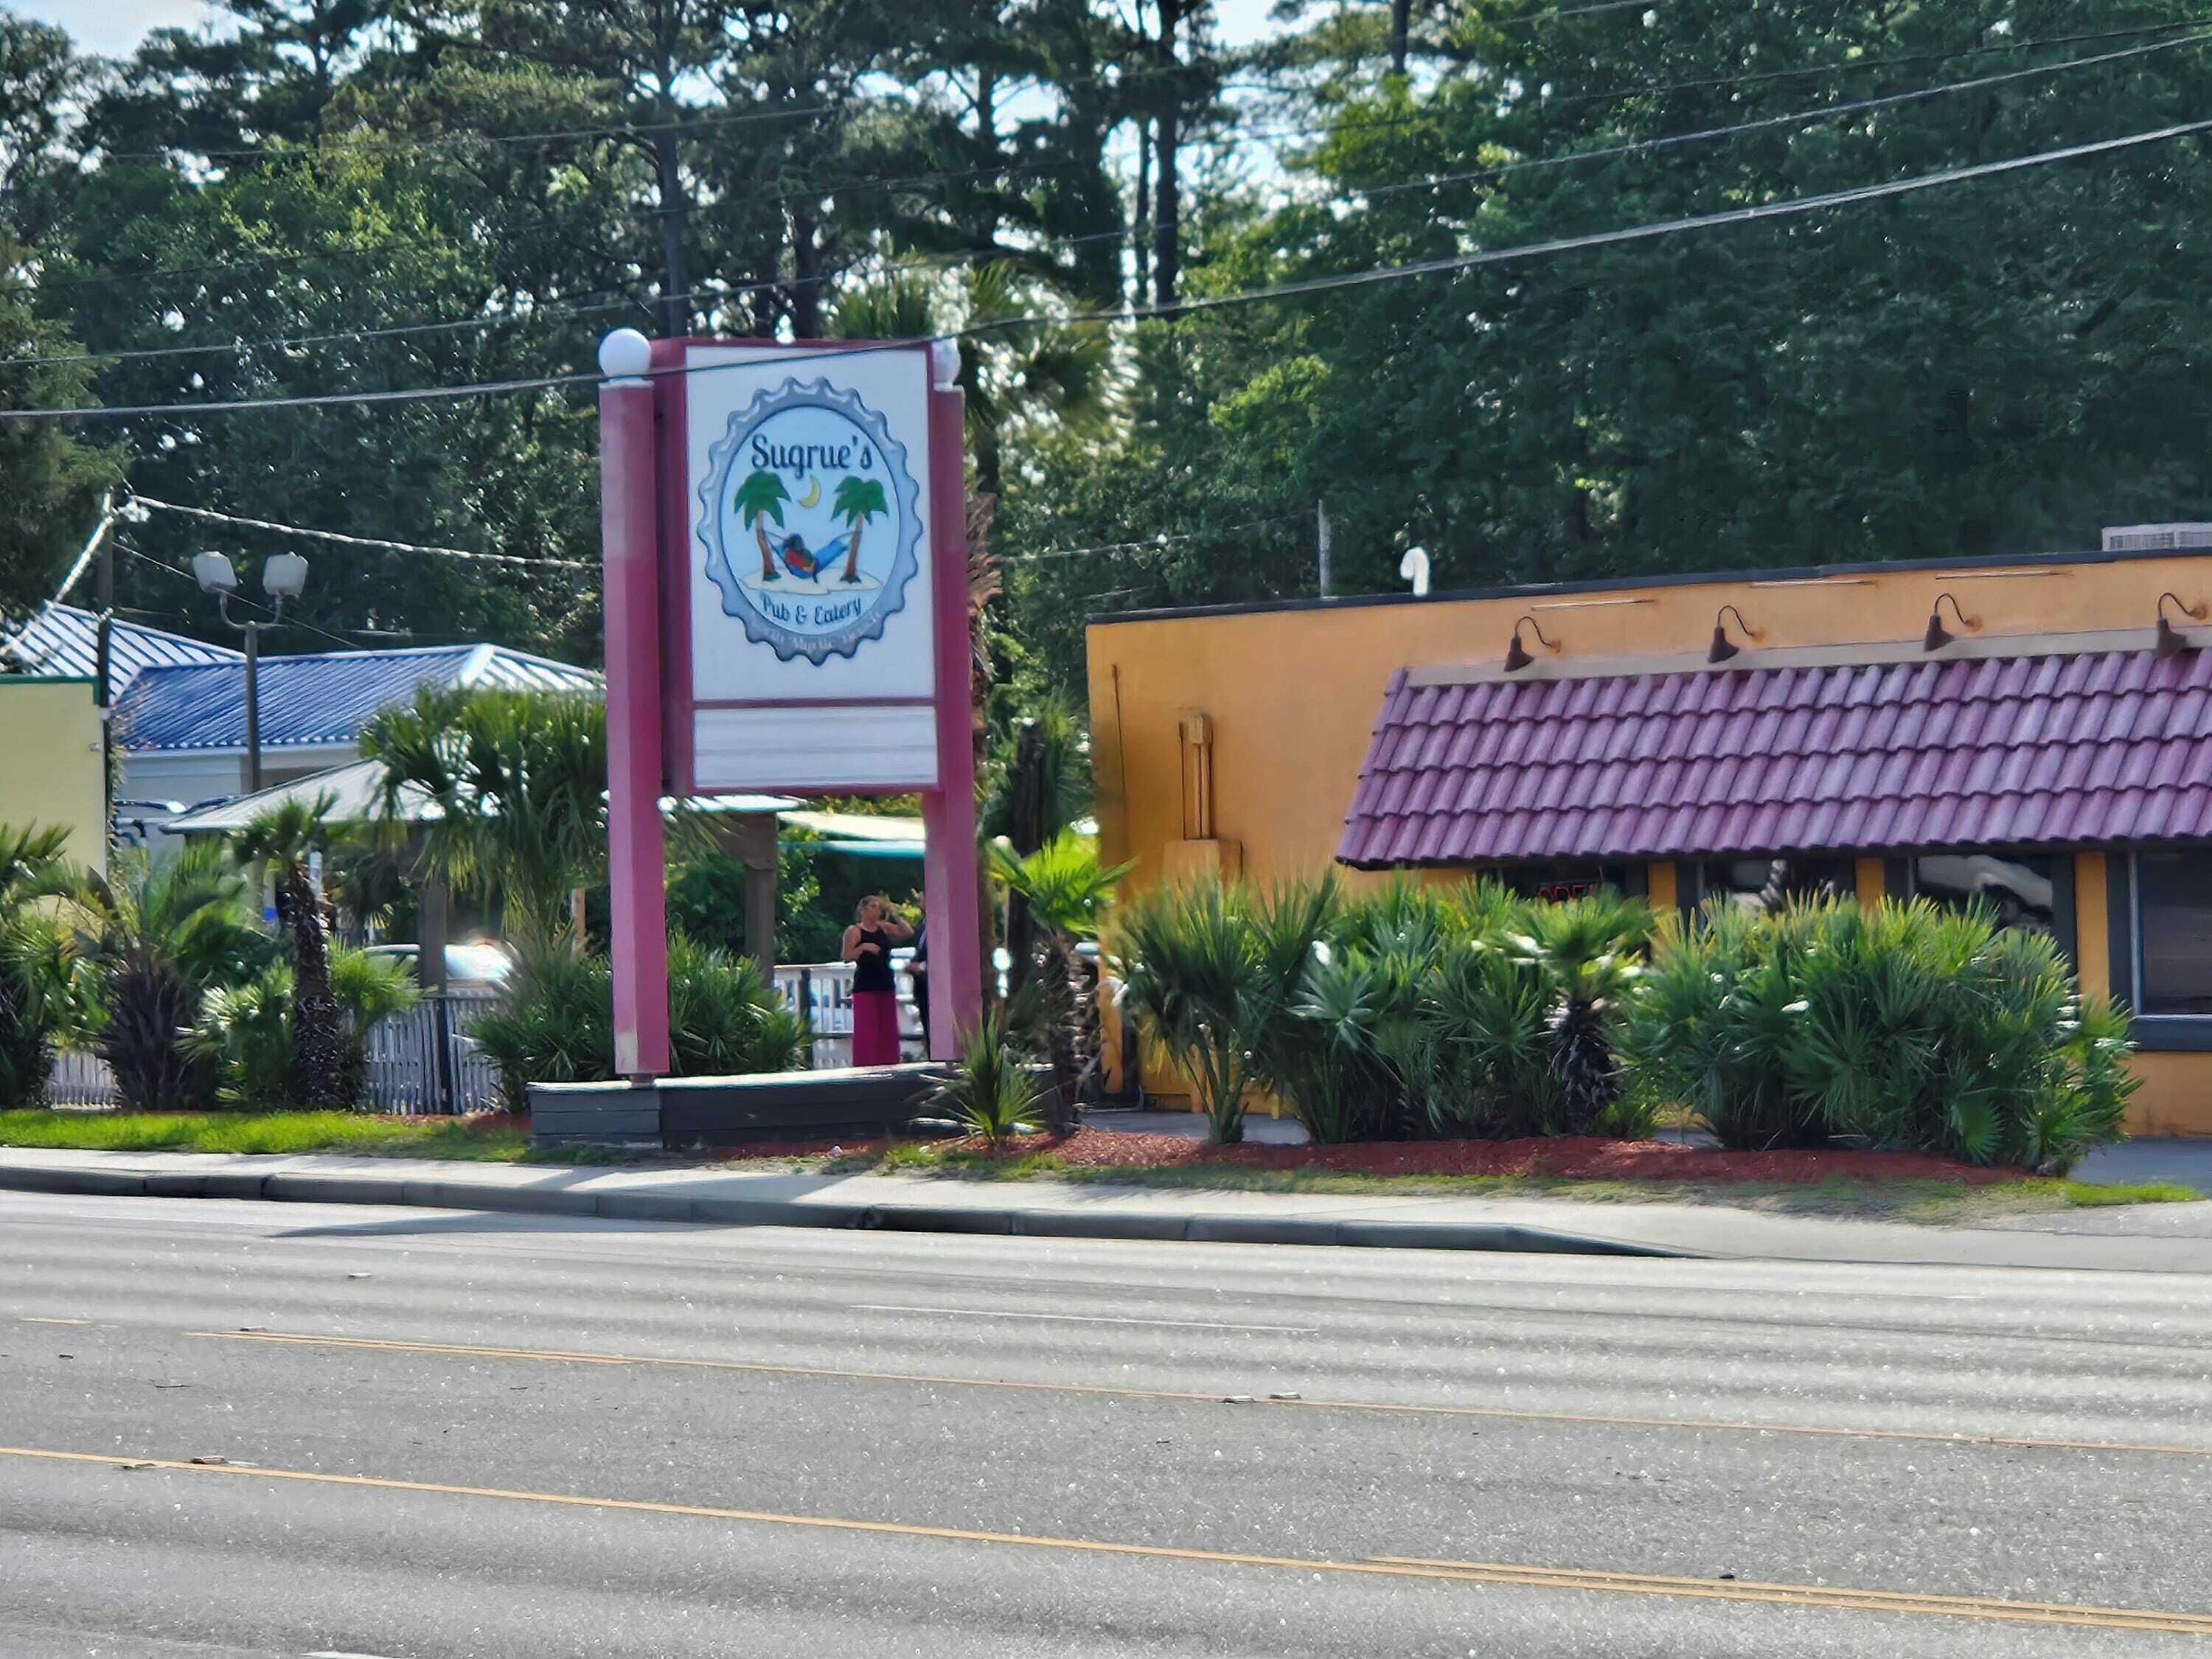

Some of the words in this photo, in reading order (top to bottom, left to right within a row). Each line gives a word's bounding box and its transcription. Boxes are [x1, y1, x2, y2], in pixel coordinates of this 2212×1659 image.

[751, 434, 872, 479] Sugrue's
[761, 592, 790, 622] Pub
[796, 605, 807, 625] &
[814, 597, 861, 625] Eatery
